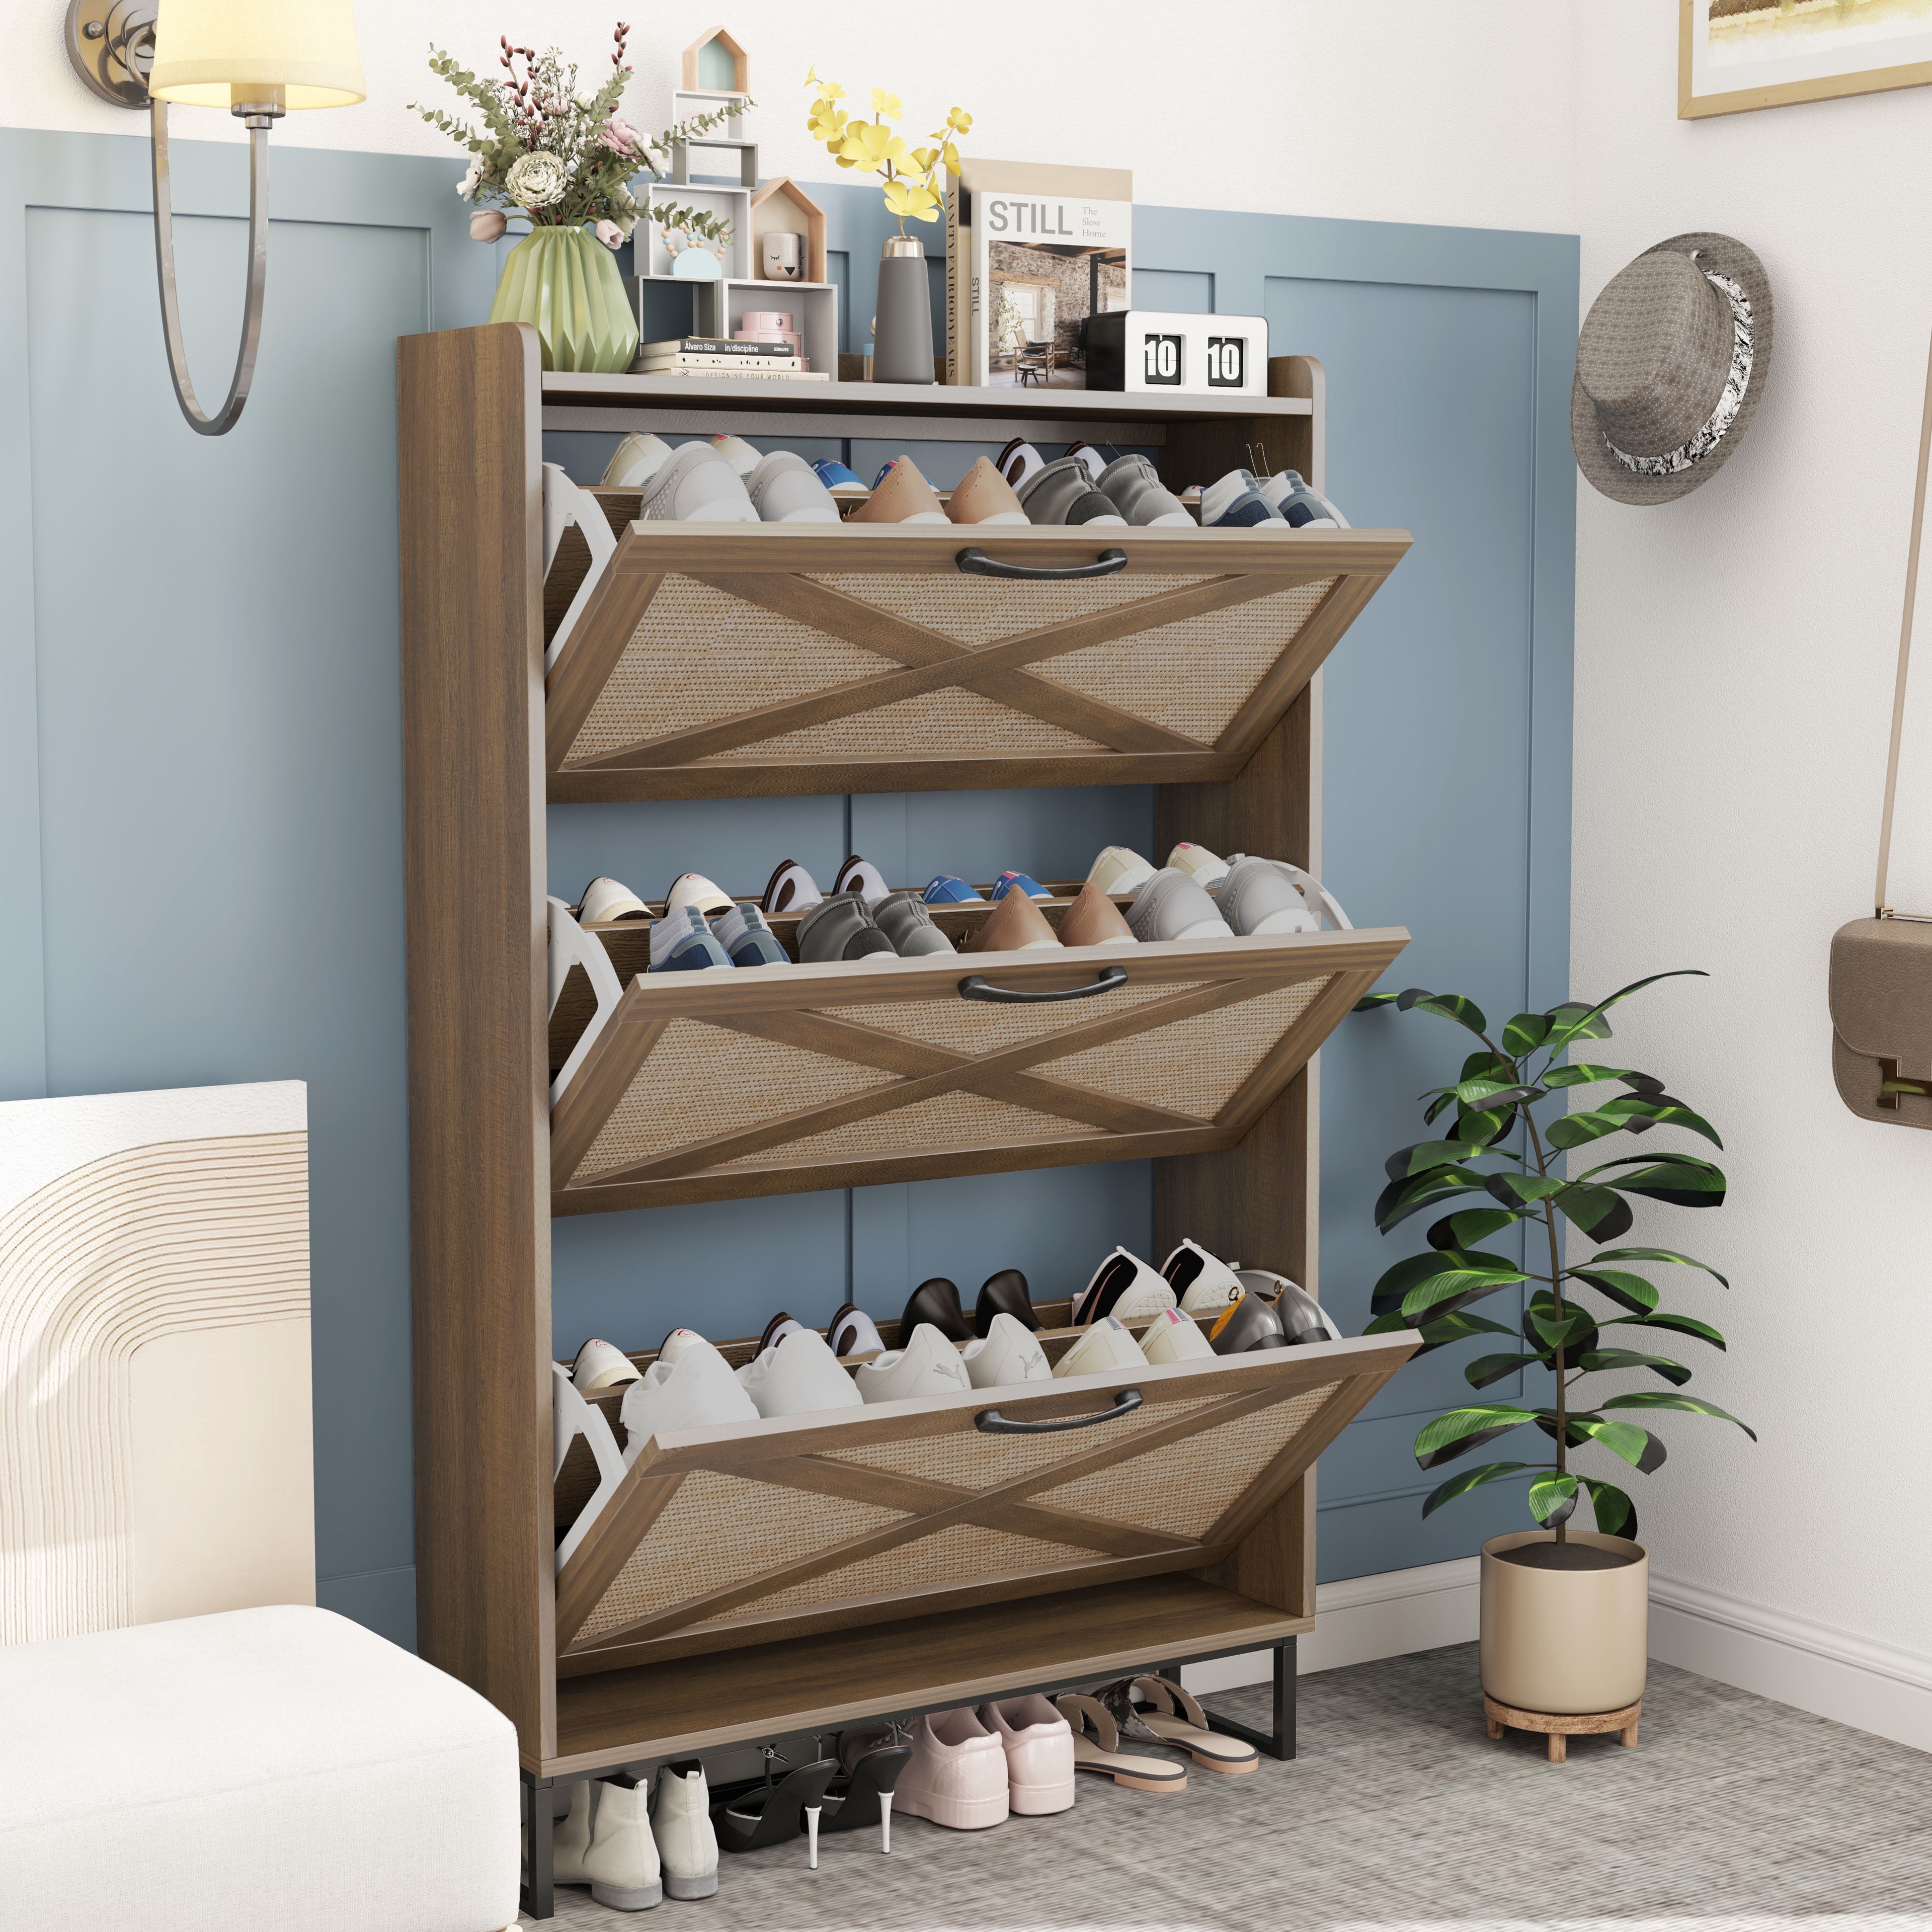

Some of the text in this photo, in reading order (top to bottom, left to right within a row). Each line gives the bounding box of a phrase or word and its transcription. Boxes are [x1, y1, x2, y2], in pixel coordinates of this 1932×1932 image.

[1082, 206, 1098, 215] The
[989, 200, 1073, 235] STILL
[1082, 218, 1101, 226] Slow
[1082, 229, 1106, 237] Home
[972, 277, 980, 316] STILL
[685, 341, 703, 350] Álvaro
[704, 343, 716, 351] Siza
[725, 344, 759, 353] in/discipline
[1145, 340, 1239, 380] 10 10
